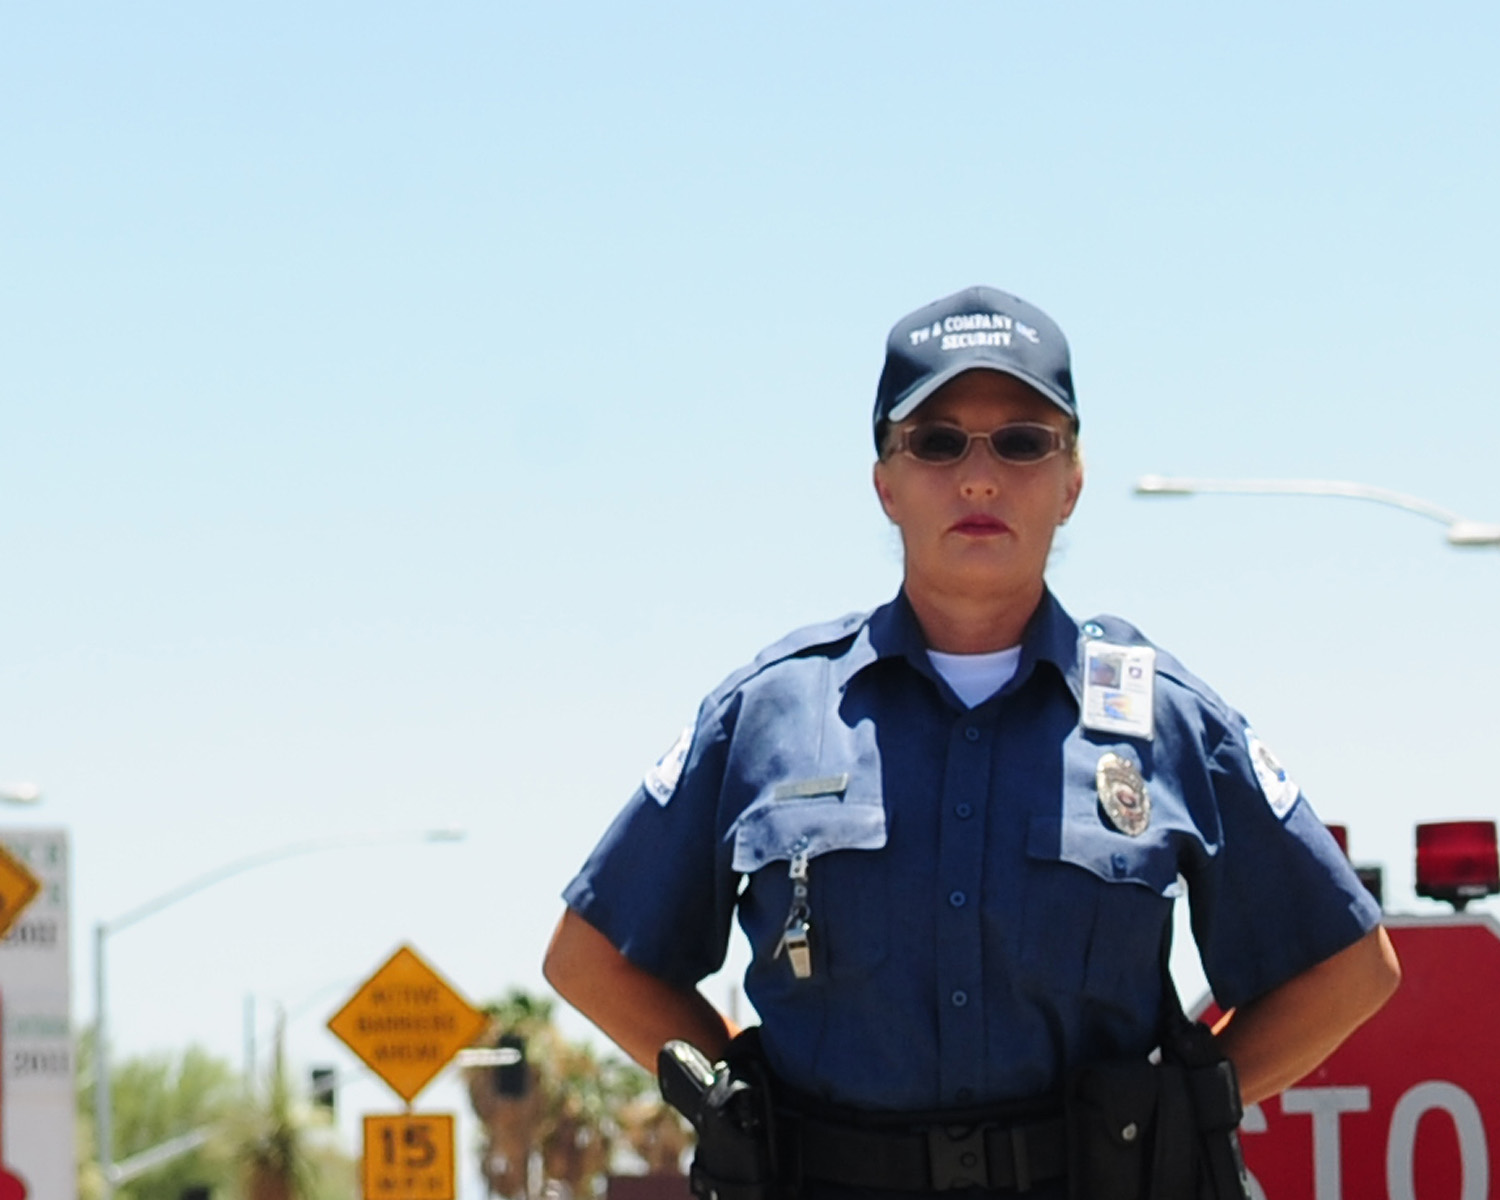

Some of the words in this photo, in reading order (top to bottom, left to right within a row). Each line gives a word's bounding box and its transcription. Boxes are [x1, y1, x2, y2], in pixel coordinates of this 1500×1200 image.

[944, 313, 1012, 332] COMPANY
[941, 331, 1011, 350] SECURITY
[381, 1124, 438, 1168] 15
